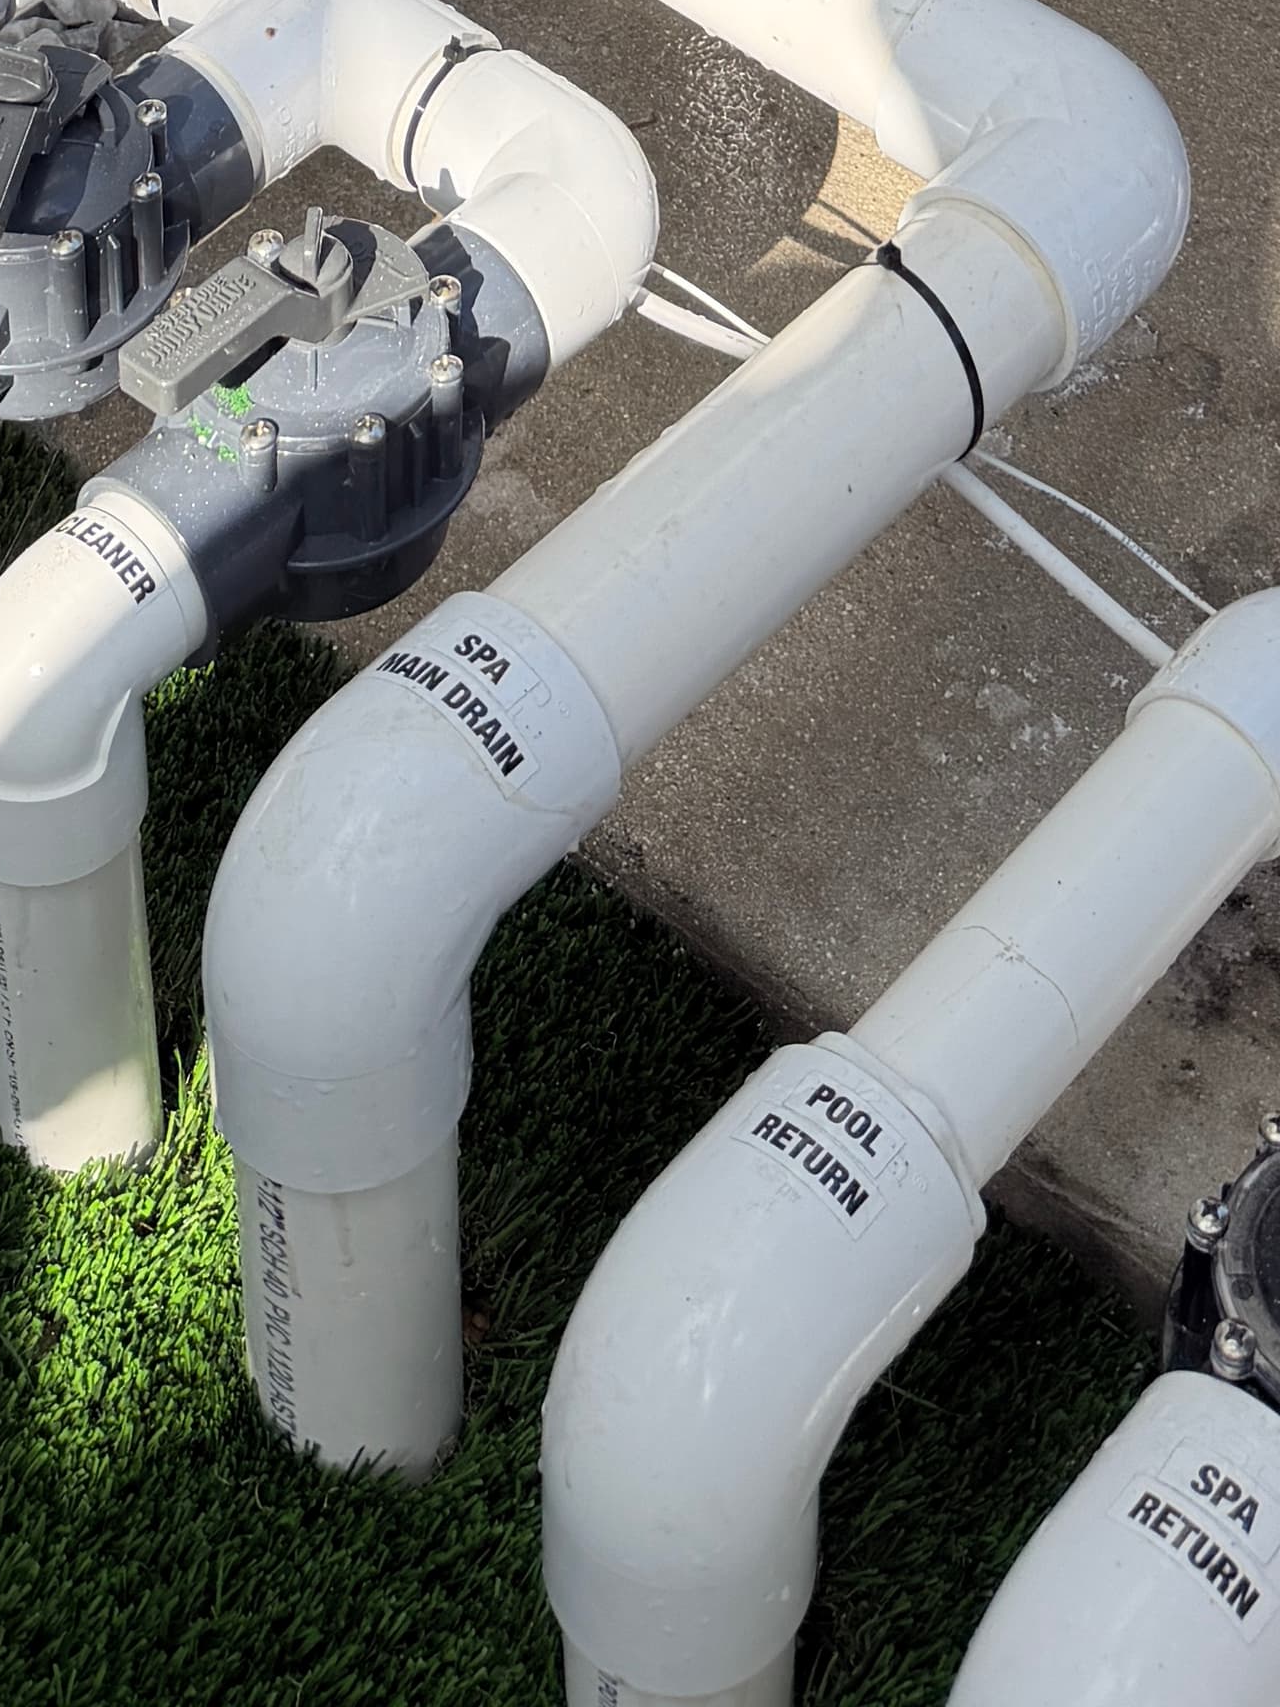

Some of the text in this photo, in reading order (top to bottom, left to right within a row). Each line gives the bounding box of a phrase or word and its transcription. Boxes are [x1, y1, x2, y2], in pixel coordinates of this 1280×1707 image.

[54, 516, 157, 606] CLEANER
[453, 633, 512, 686] SPA
[375, 652, 525, 778] MAIN DRAIN
[805, 1083, 884, 1158] POOL
[751, 1112, 871, 1218] RETURN
[259, 1222, 289, 1275] SCH
[262, 1270, 290, 1300] 40
[264, 1294, 292, 1347] PVC
[266, 1344, 296, 1394] 1120
[1190, 1463, 1260, 1536] SPA
[1127, 1490, 1261, 1621] RETURN
